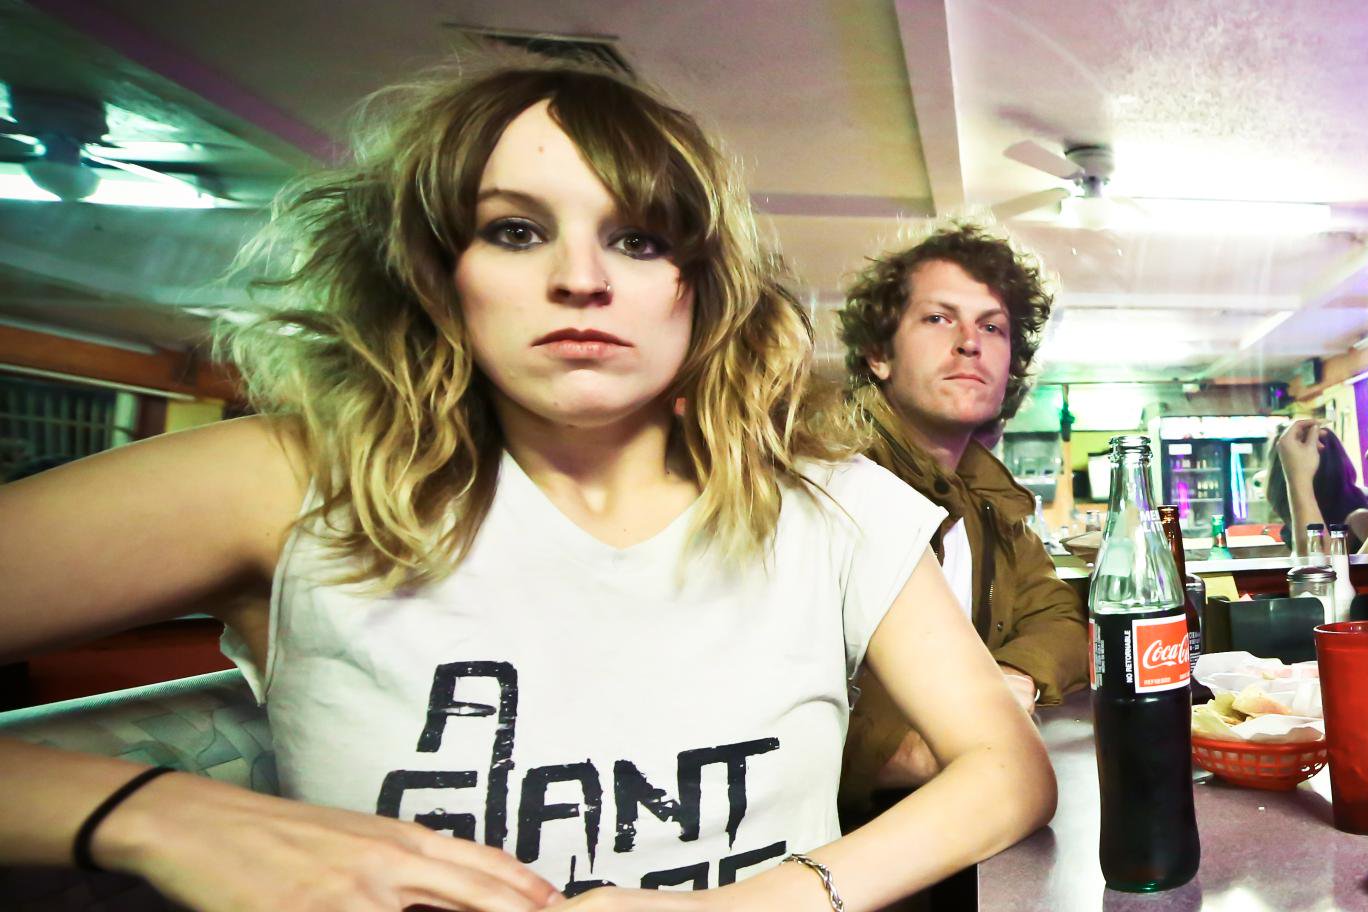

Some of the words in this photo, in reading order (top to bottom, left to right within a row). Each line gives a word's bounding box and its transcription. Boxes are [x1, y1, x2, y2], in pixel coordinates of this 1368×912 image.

[1124, 630, 1132, 673] RETORNABLE
[1126, 673, 1133, 683] NO
[416, 660, 518, 772] A
[375, 737, 780, 873] GIANT
